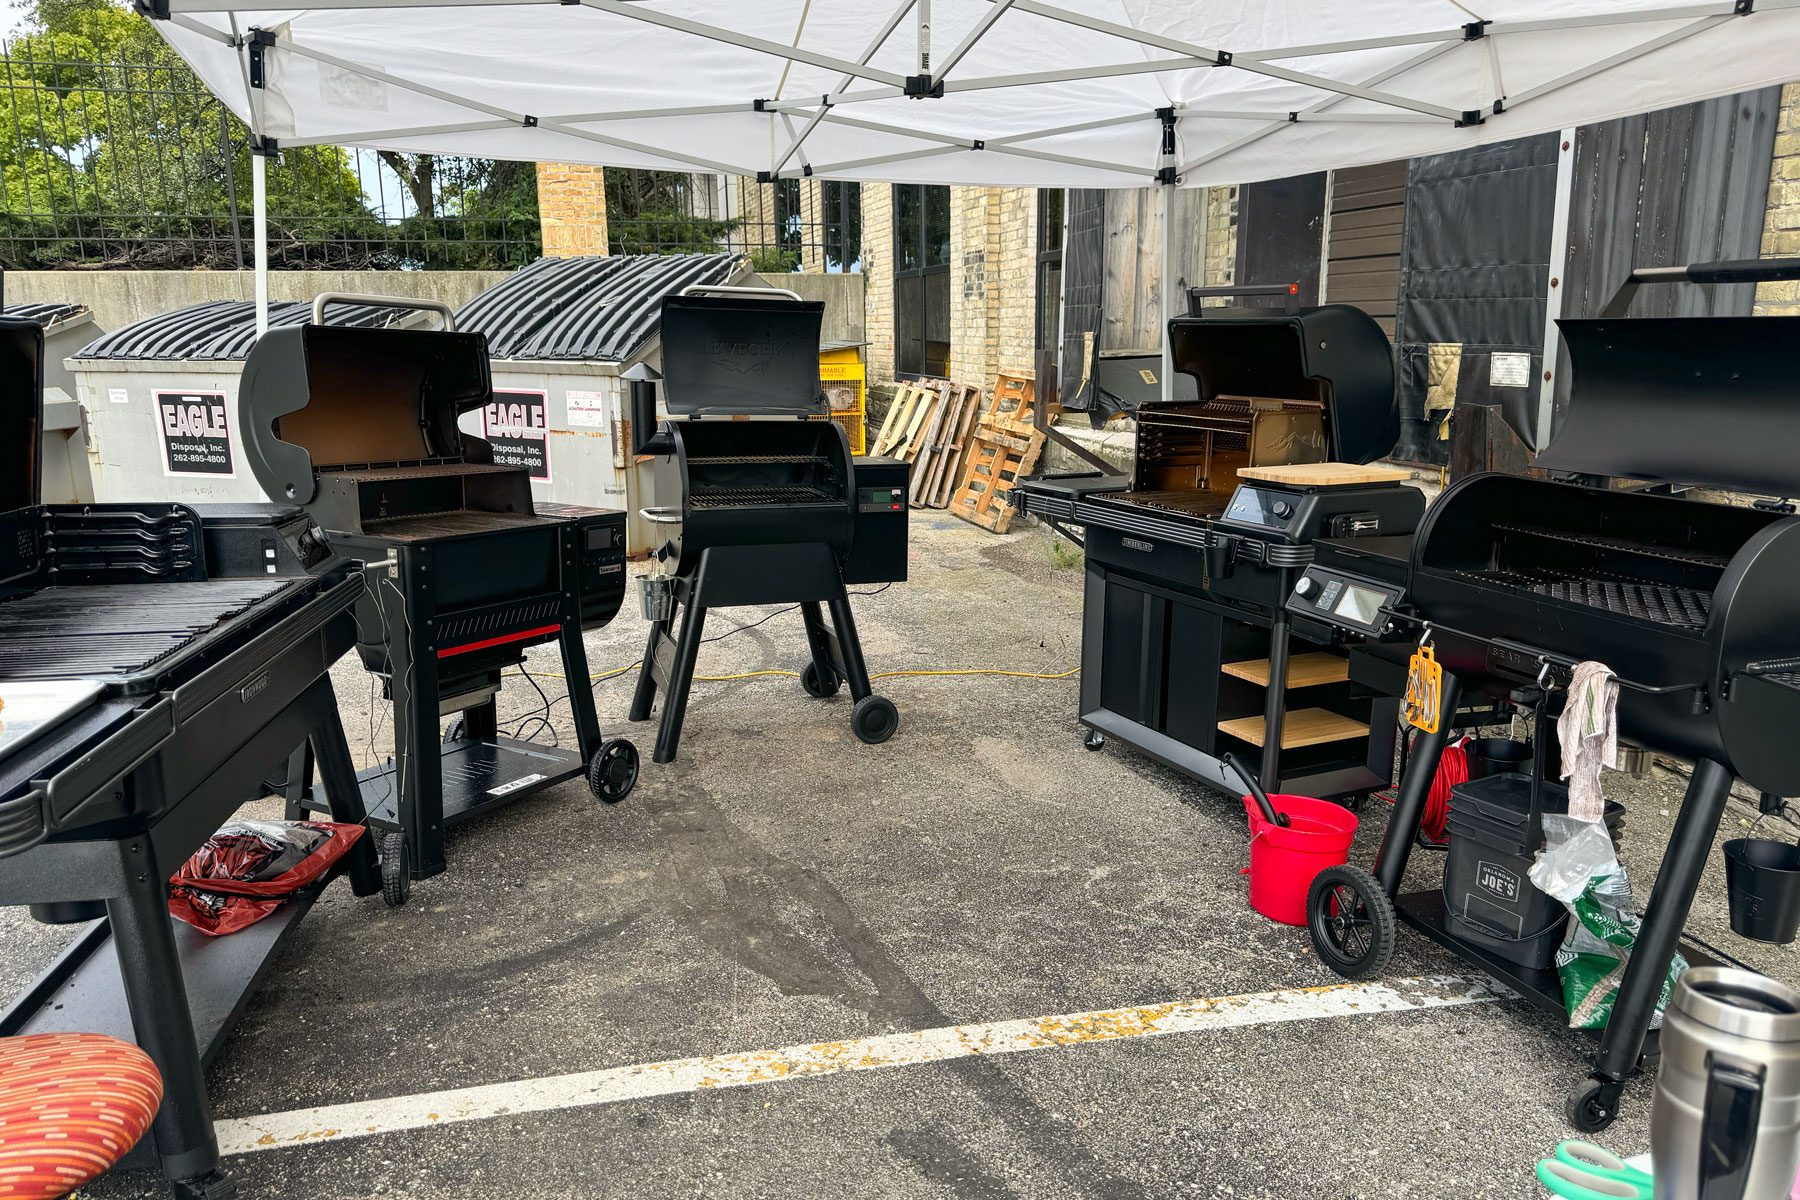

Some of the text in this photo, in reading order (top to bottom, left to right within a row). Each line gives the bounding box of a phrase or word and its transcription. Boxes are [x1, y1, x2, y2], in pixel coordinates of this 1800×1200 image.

[162, 404, 227, 438] EAGLE
[485, 402, 544, 440] EAGLE
[171, 443, 226, 455] Disposal, Inc.
[527, 446, 542, 455] Inc.
[173, 454, 226, 463] 262-895-4800
[1492, 647, 1521, 664] SEAR
[1482, 866, 1515, 884] OKLAHOMA
[1481, 873, 1516, 897] JOE'S
